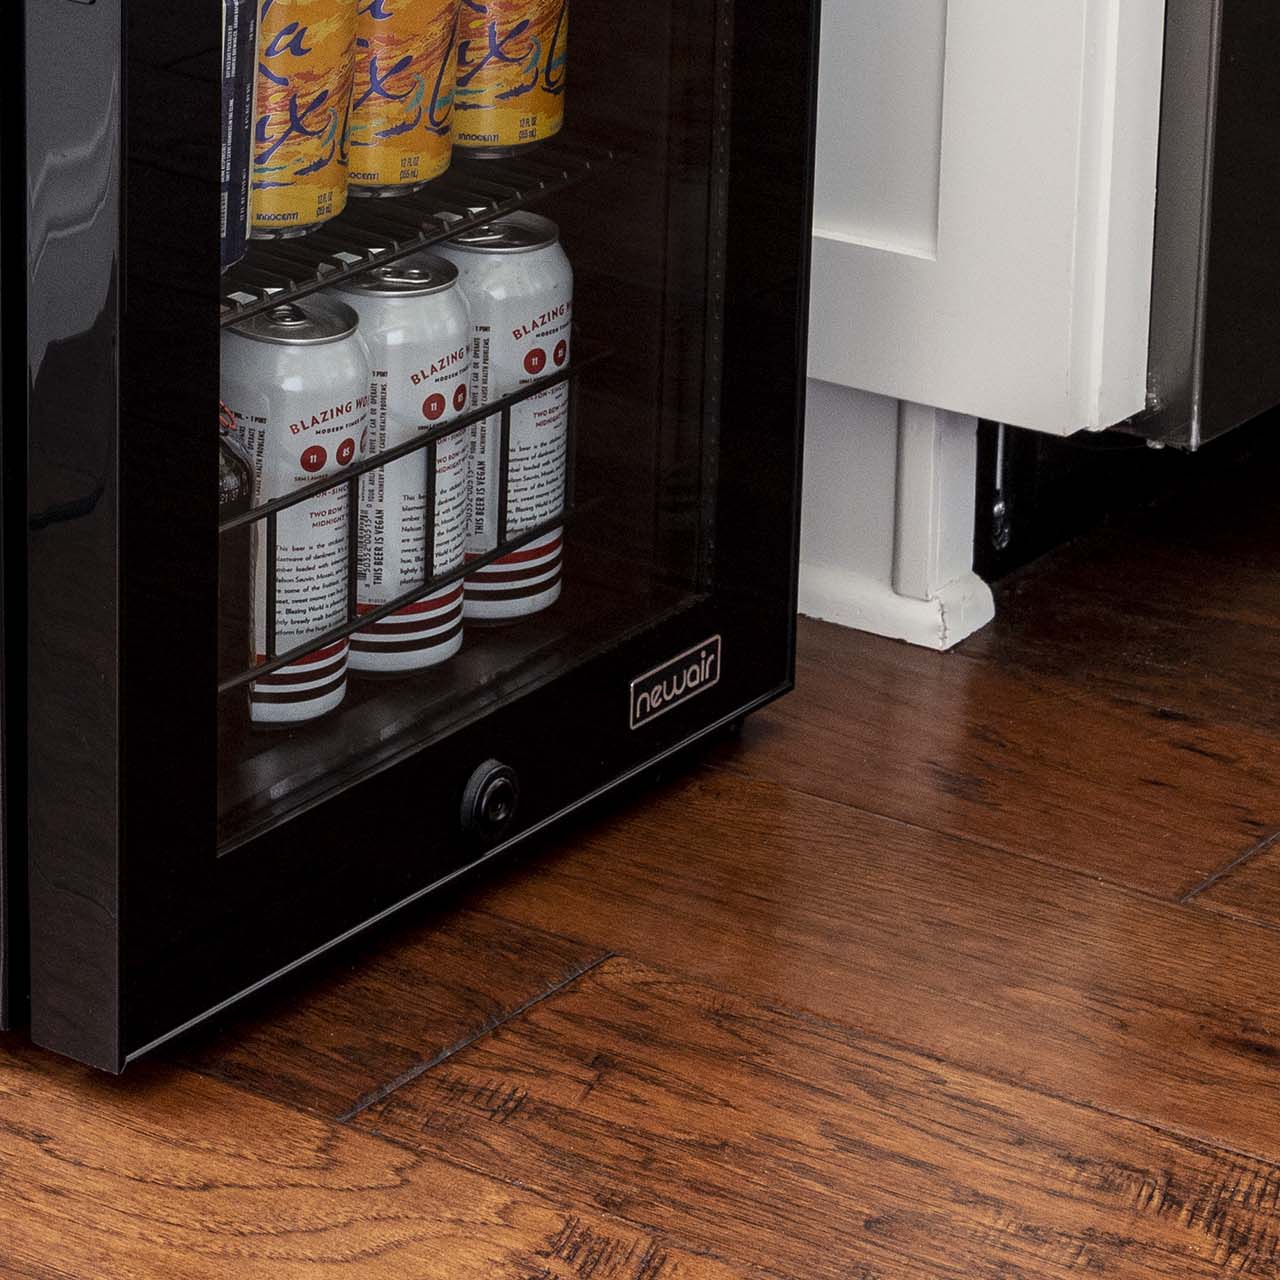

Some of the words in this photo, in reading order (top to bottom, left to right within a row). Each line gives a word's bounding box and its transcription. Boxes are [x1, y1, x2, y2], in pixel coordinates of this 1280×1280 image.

[513, 304, 565, 340] BLAZING
[411, 347, 464, 385] BLAZING
[531, 357, 538, 366] 11
[430, 401, 438, 412] 11
[290, 401, 352, 435] BLAZING
[309, 454, 317, 464] 11
[476, 460, 486, 485] VEGAN
[310, 510, 327, 519] TWO
[476, 498, 485, 515] BEER
[374, 509, 384, 535] VEGAN
[475, 518, 484, 534] THIS
[374, 547, 383, 565] BEER
[373, 568, 382, 585] THIS
[636, 650, 715, 718] newair
